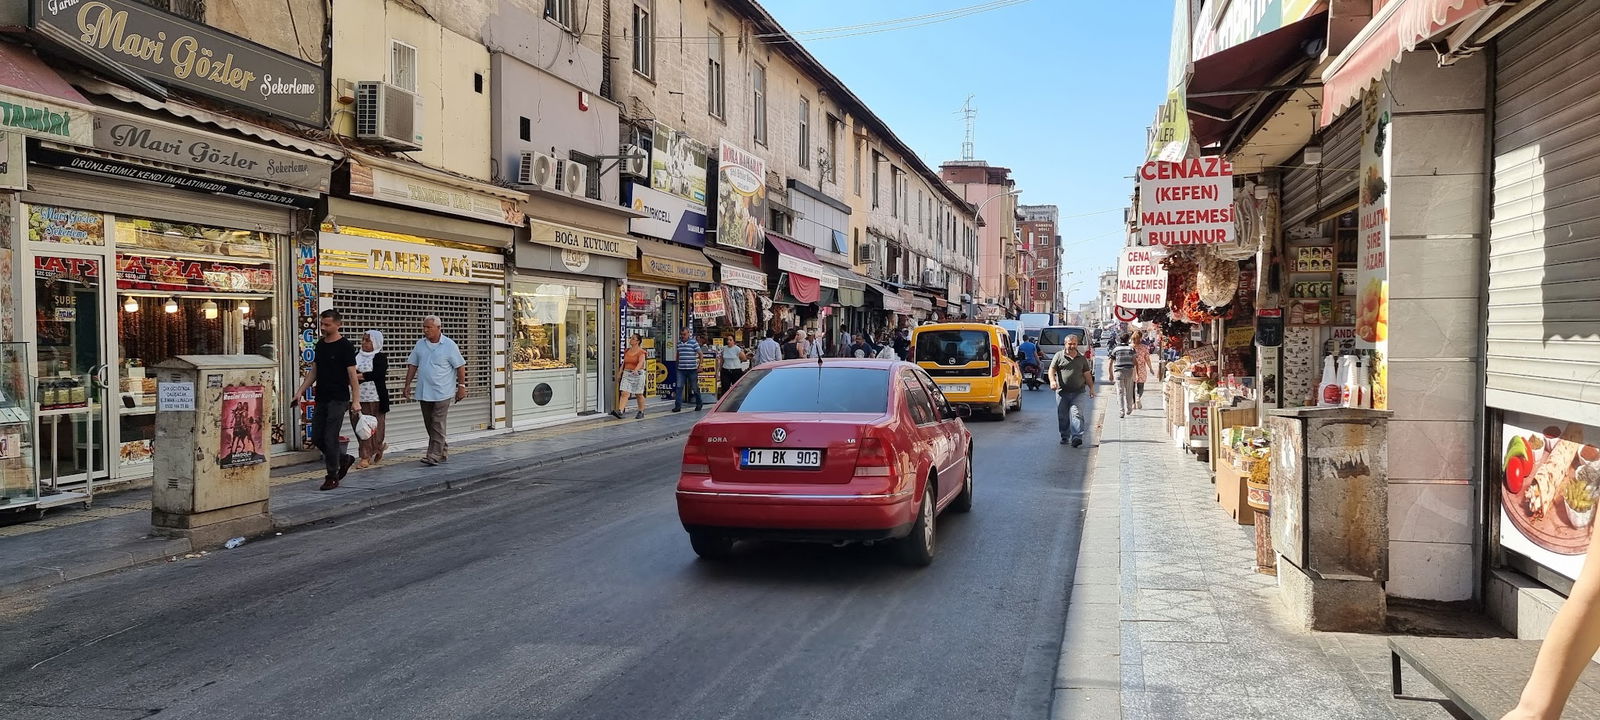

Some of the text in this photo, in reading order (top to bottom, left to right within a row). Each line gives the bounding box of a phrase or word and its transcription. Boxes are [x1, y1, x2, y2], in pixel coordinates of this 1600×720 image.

[76, 1, 316, 101] Mavi Gözler Şekerleme
[110, 124, 181, 156] Mavi
[188, 142, 258, 175] Gözler
[71, 157, 136, 178] ÜRÜNLERİMİZ
[136, 170, 165, 183] KENDİ
[165, 174, 227, 193] İMALATIMIZDIR
[1141, 157, 1233, 180] CENAZE
[408, 184, 450, 208] TAMER
[1155, 184, 1218, 204] (KEFEN)
[1141, 204, 1235, 226] MALZEMESİ
[555, 230, 620, 254] BOĞA KUYUMCU
[1148, 229, 1227, 246] BULUNUR
[370, 248, 431, 274] TAMER
[440, 254, 470, 277] YAĞ
[1128, 251, 1151, 262] CENA
[300, 246, 315, 316] MAVİ
[1127, 265, 1159, 278] (KEFEN)
[1119, 277, 1166, 290] MALZEMESİ
[1122, 293, 1161, 304] BULUNUR
[749, 451, 762, 464] 01
[772, 451, 786, 465] BK
[797, 451, 818, 465] 903
